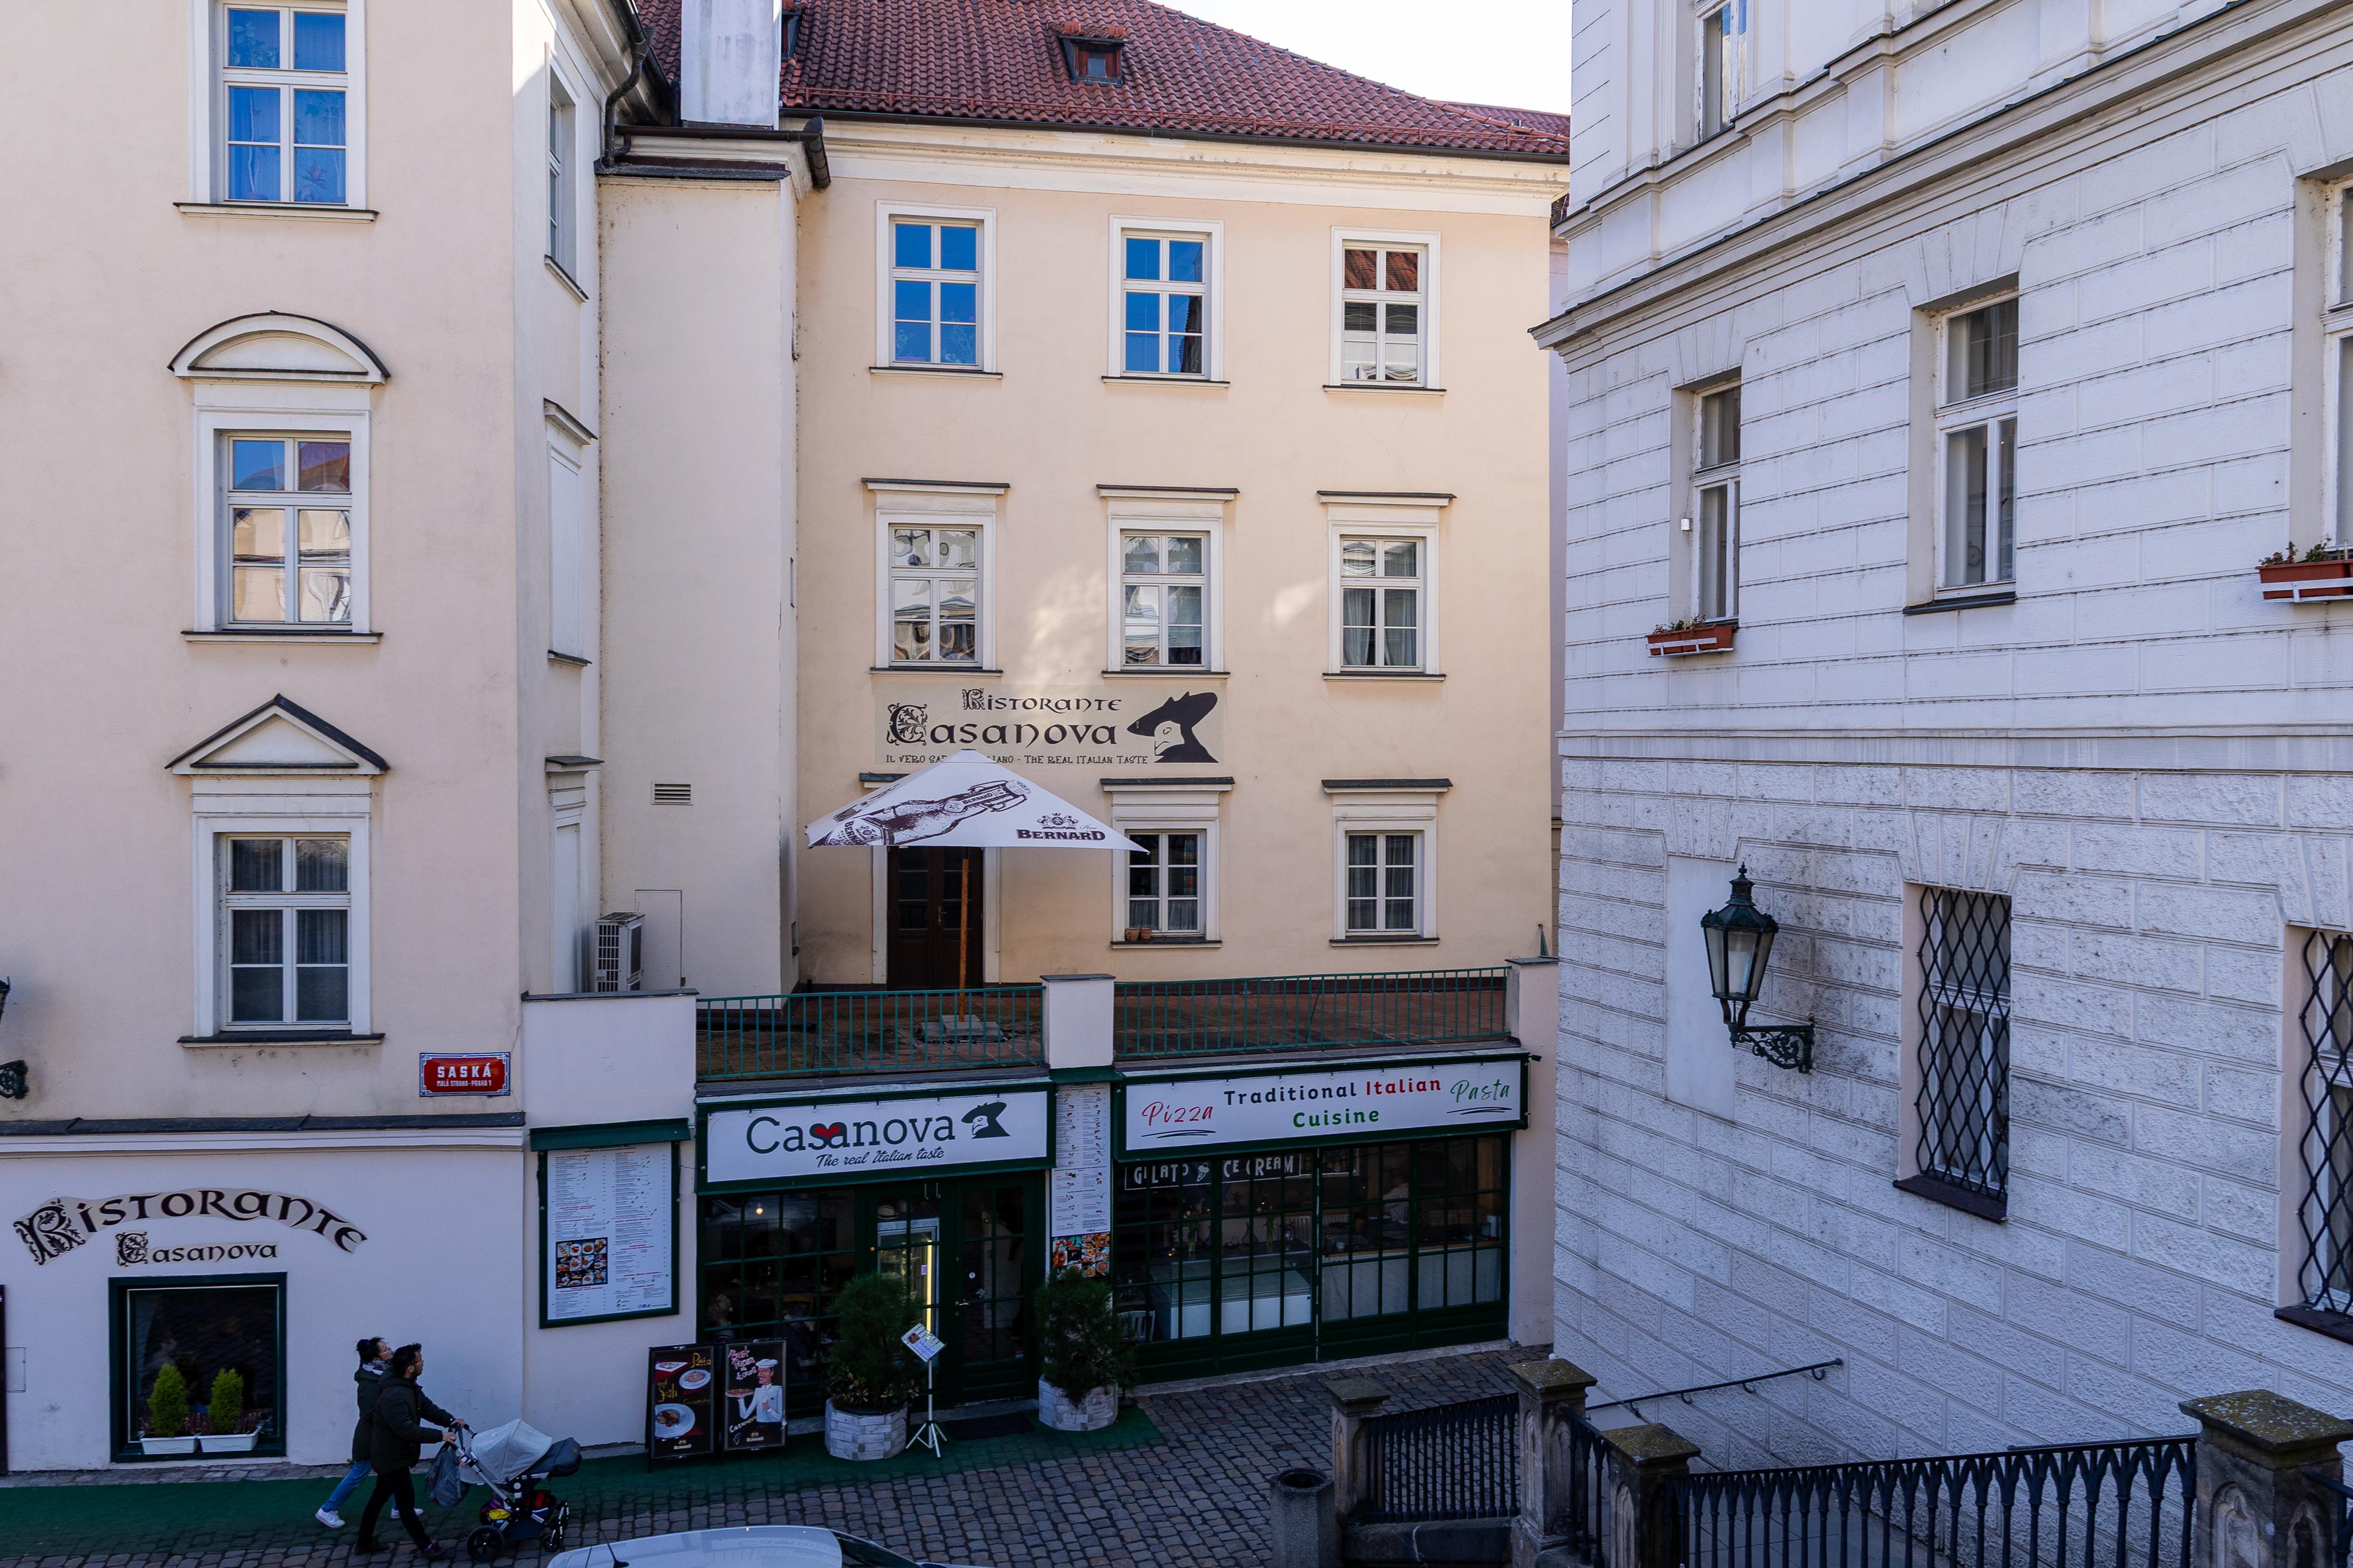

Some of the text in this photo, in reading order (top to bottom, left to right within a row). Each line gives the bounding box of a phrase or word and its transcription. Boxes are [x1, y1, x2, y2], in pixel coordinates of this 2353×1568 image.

[961, 688, 1122, 713] Ristorante
[886, 702, 1118, 748] Casanova
[898, 755, 926, 764] VERO
[1024, 755, 1044, 764] THE
[1047, 755, 1072, 764] REAL
[1076, 755, 1113, 764] ITALIAN
[1116, 755, 1148, 764] TASTE
[962, 792, 993, 805] BERNARD
[1016, 829, 1106, 841] BERNARD
[438, 1063, 491, 1077] SASKÁ
[1224, 1077, 1441, 1105] Traditional Italian
[1449, 1079, 1511, 1103] Pasta
[1141, 1101, 1215, 1126] Pizza
[1292, 1108, 1379, 1128] Cuisine
[746, 1115, 956, 1154] Casanova
[816, 1146, 945, 1168] The real Italian taste
[1223, 1159, 1239, 1177] CE
[13, 1189, 368, 1266] Ristorante
[115, 1231, 278, 1267] Casanova
